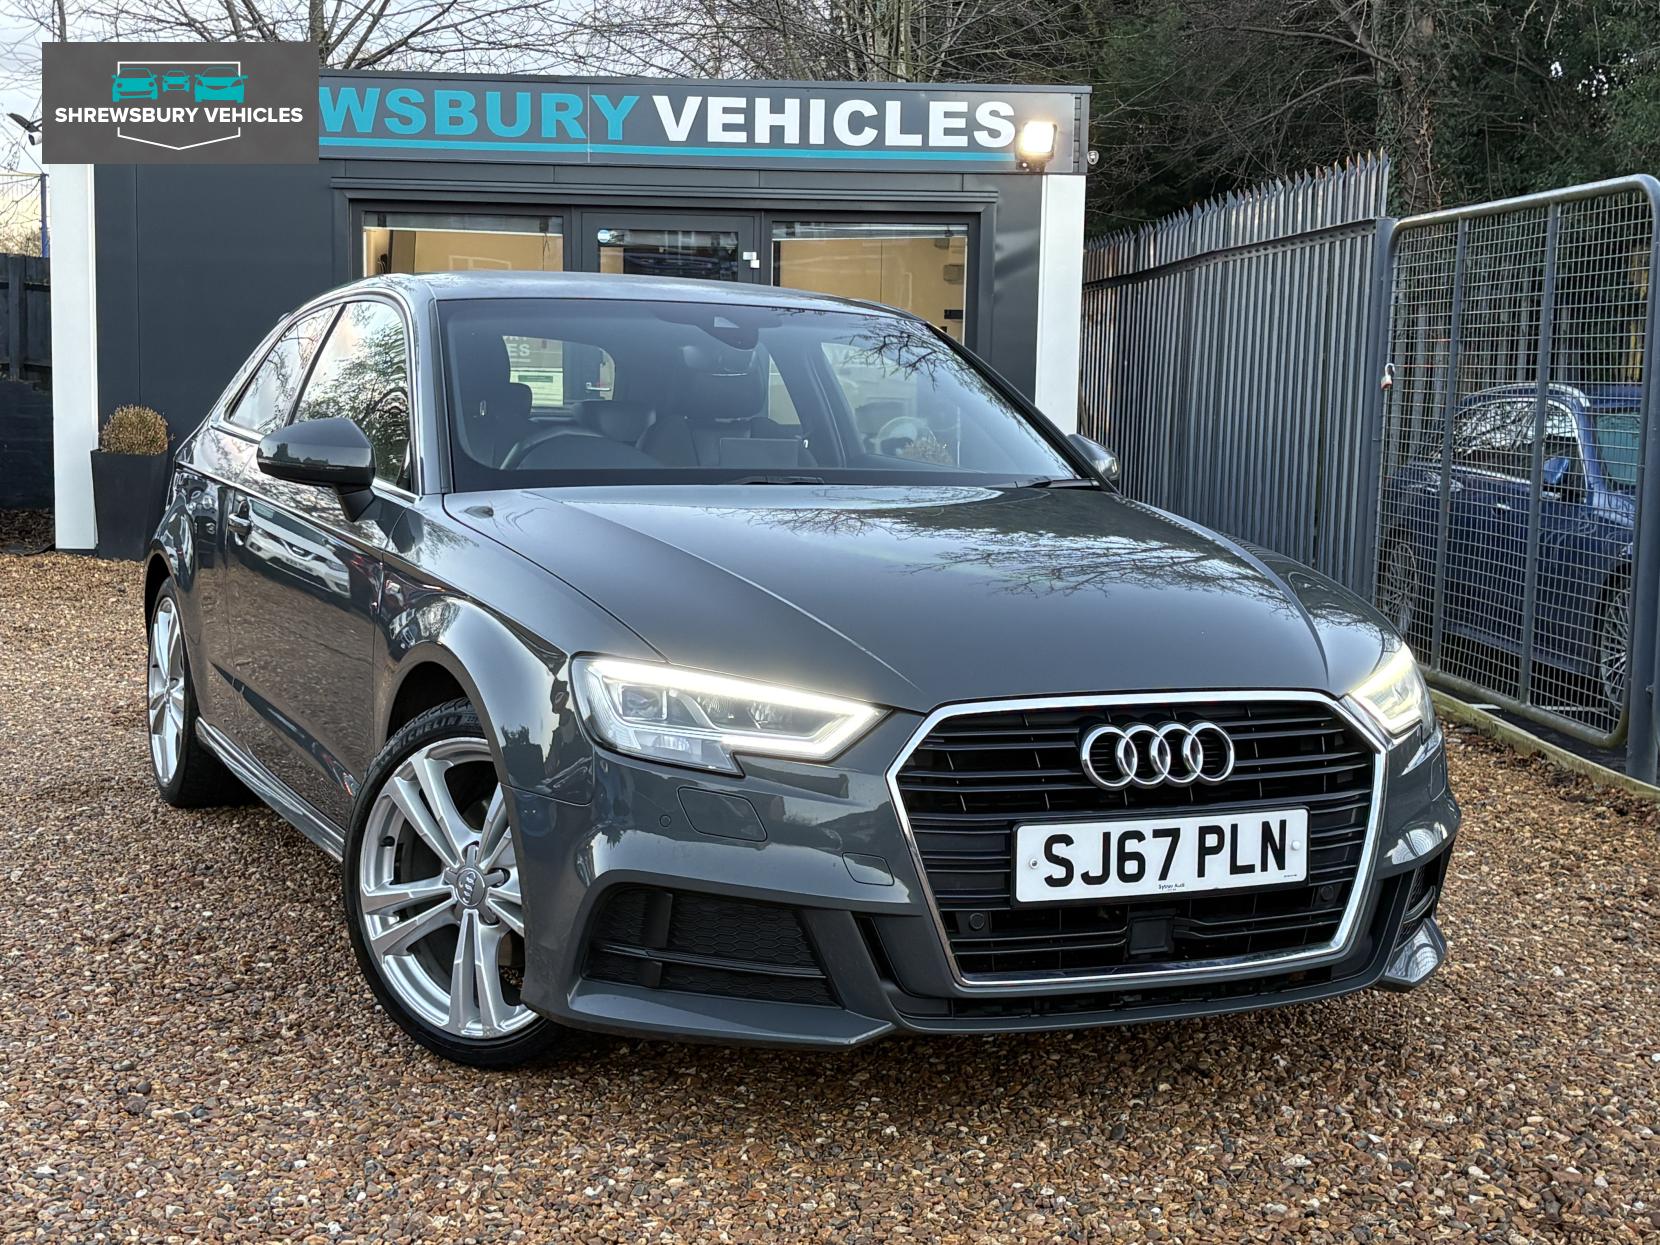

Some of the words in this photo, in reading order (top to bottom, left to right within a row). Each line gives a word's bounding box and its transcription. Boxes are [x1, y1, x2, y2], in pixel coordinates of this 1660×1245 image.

[652, 95, 1016, 148] VEHICLES
[1043, 827, 1181, 888] SJ67
[1196, 819, 1288, 878] PLN
